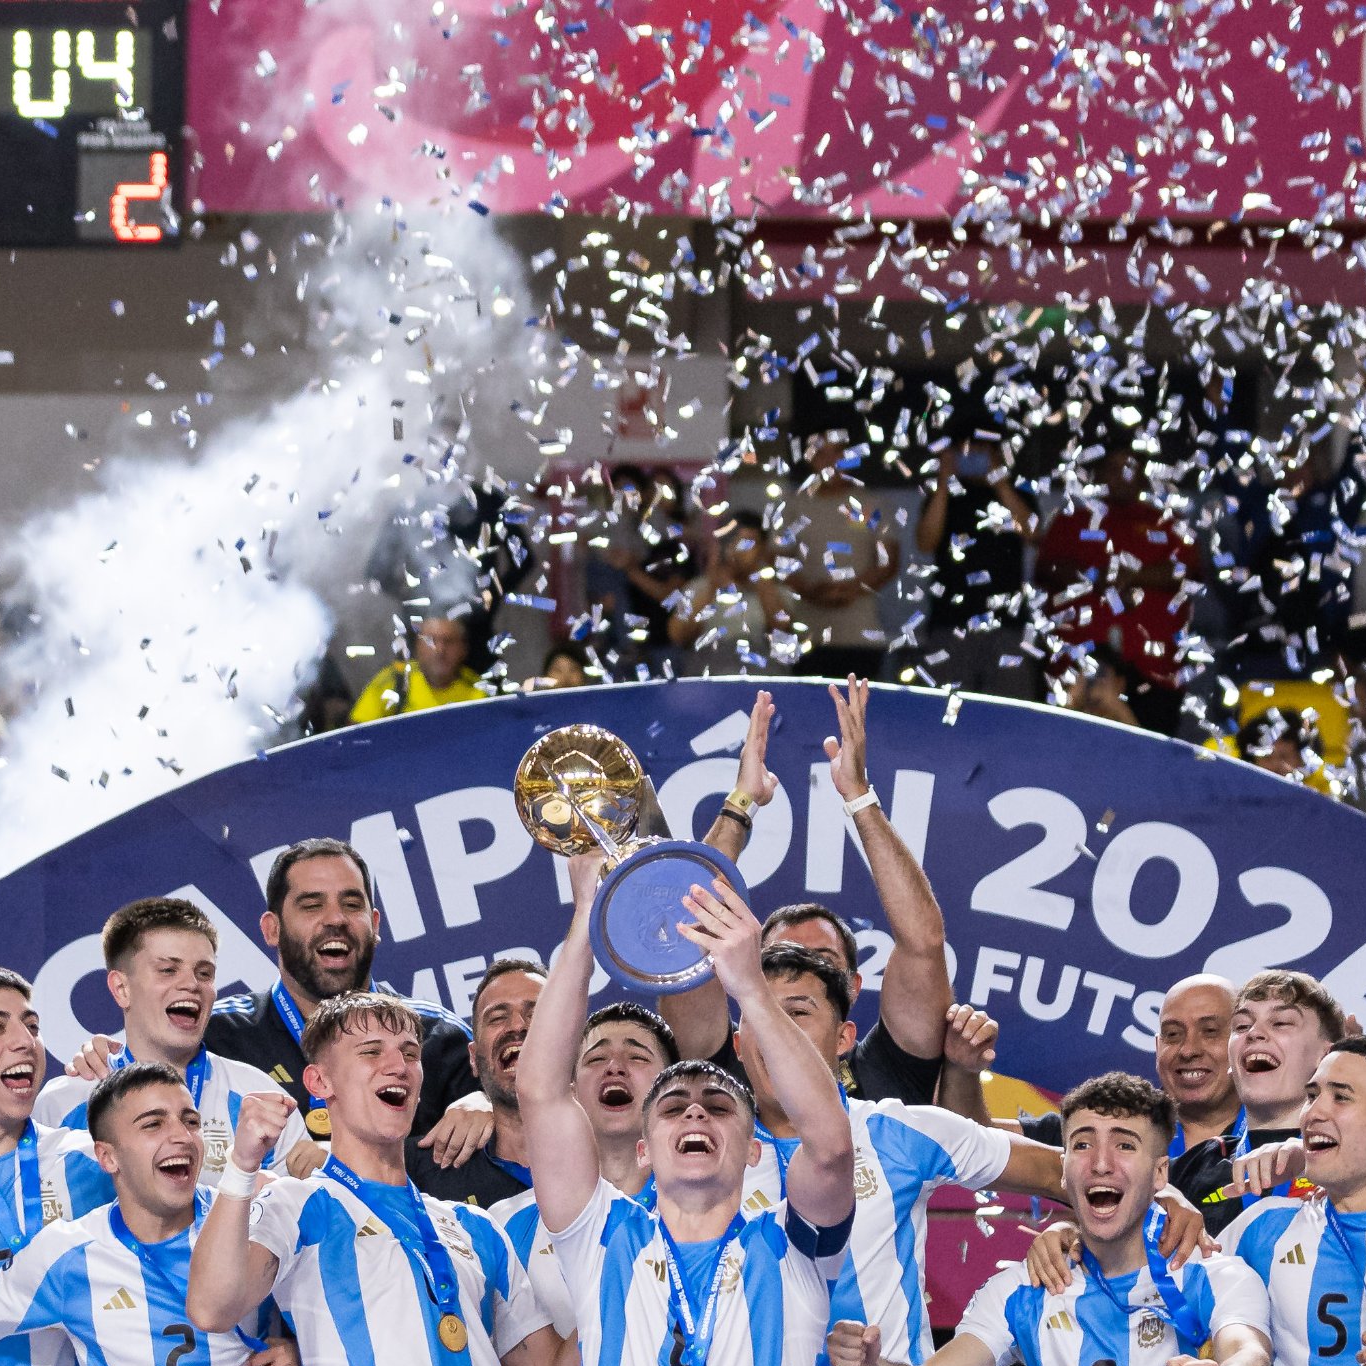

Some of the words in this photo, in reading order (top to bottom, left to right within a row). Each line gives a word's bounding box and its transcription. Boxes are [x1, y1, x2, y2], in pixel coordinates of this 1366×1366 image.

[110, 151, 167, 242] 2
[343, 1174, 360, 1190] 2024
[700, 1291, 717, 1340] CONMEBOL
[1317, 1292, 1349, 1358] 5
